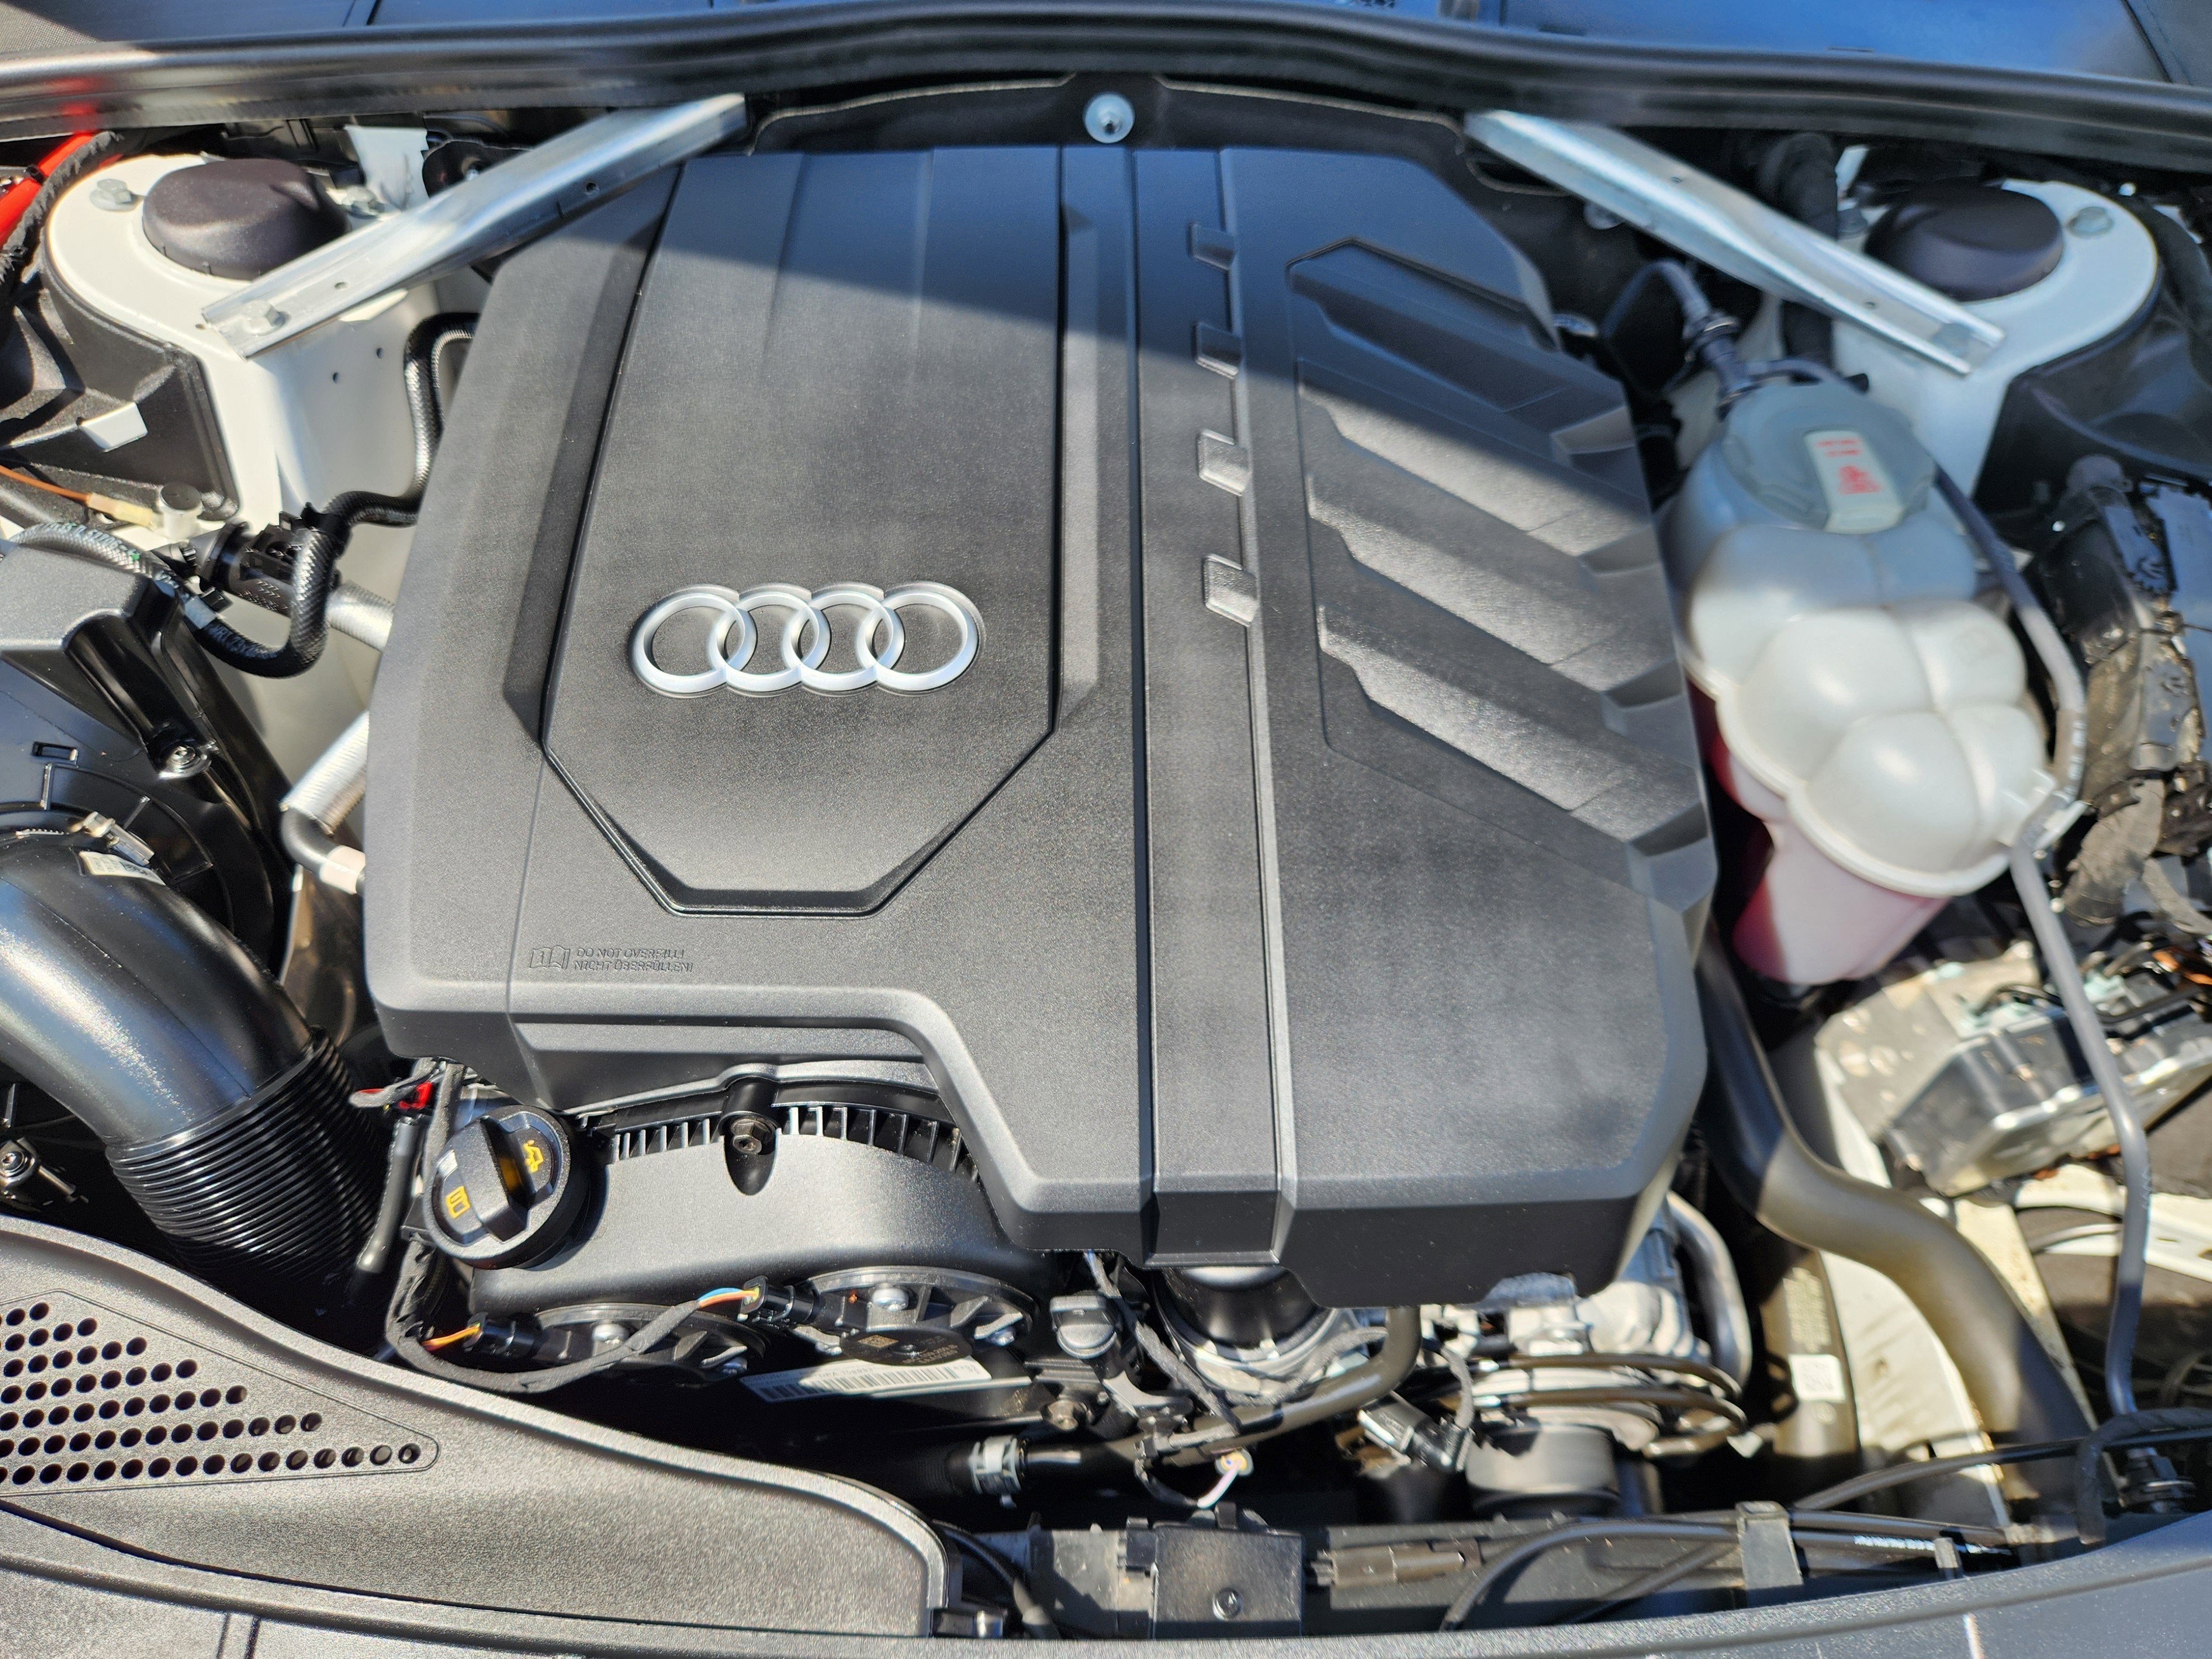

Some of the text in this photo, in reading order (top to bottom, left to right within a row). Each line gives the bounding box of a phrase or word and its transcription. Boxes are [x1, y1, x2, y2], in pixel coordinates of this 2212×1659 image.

[577, 947, 685, 959] DO NOT OVERFILL!
[574, 959, 693, 972] NICHT ÜBERFÜLLEN!
